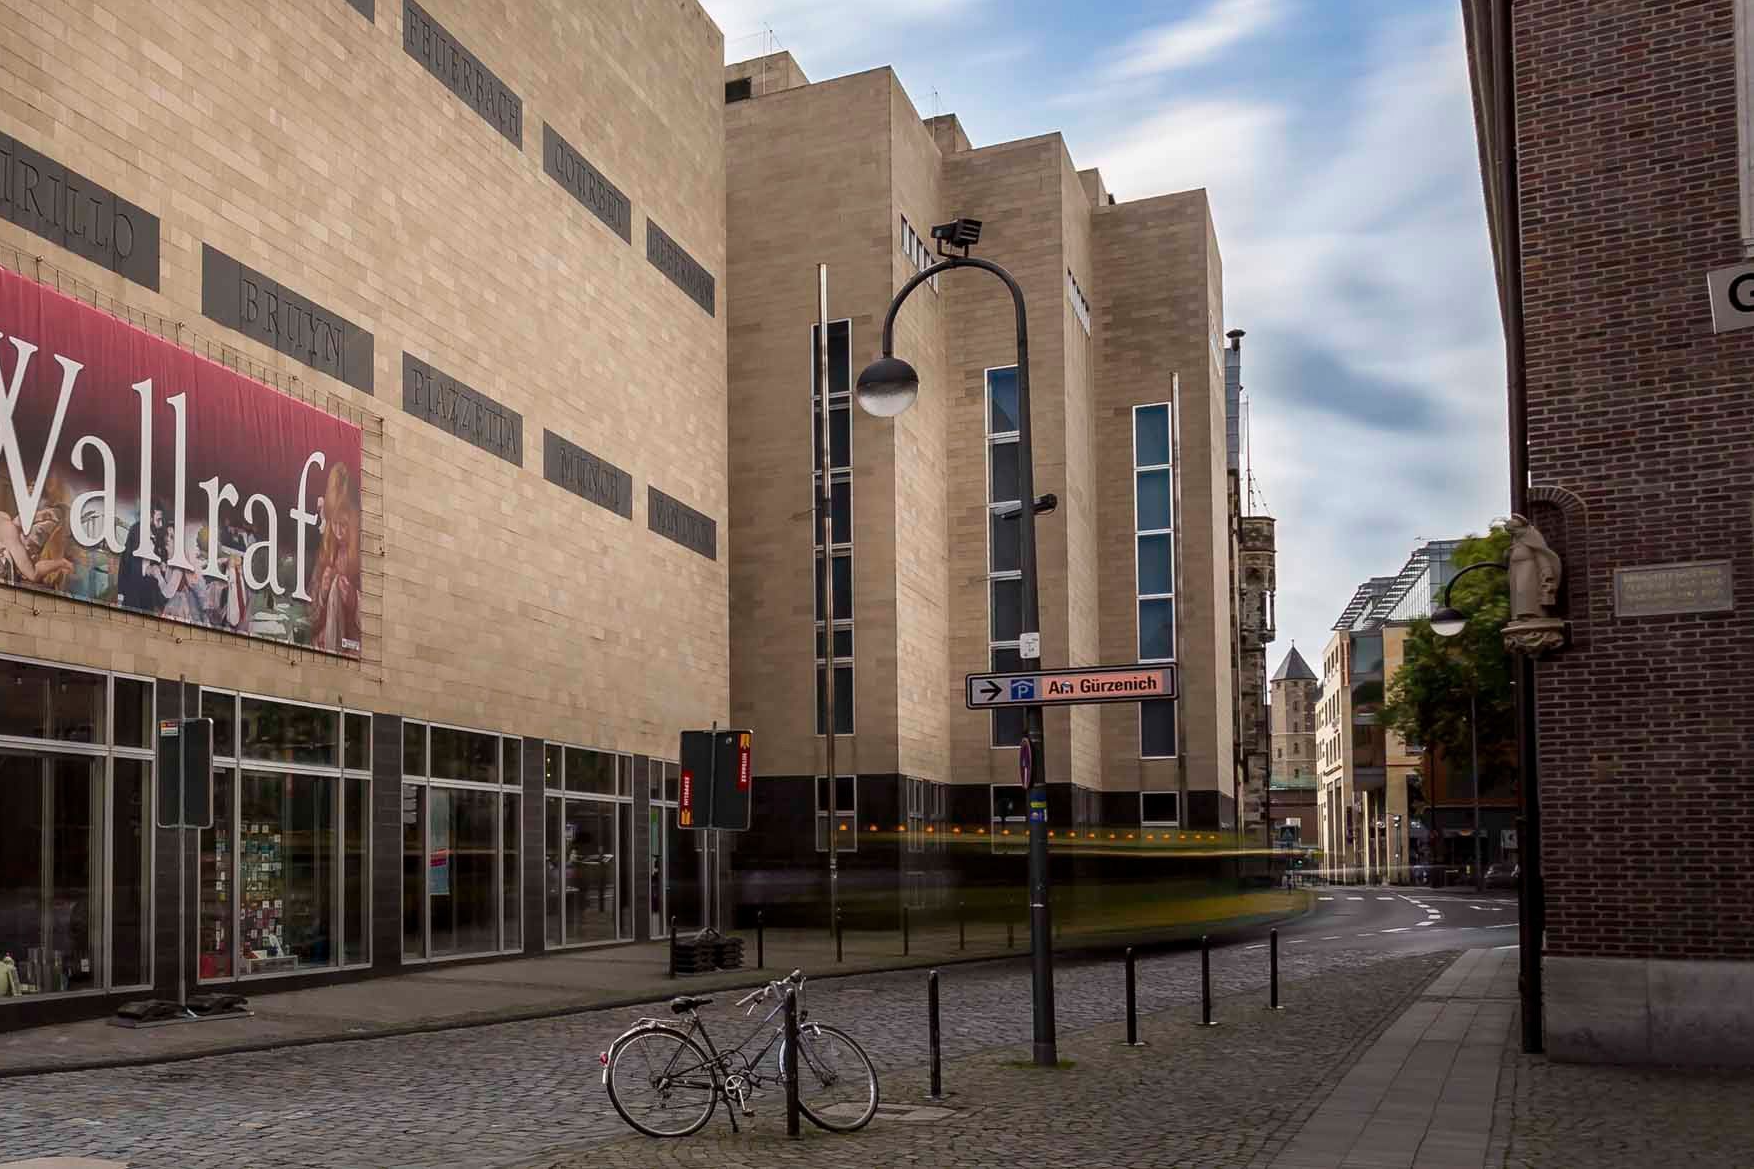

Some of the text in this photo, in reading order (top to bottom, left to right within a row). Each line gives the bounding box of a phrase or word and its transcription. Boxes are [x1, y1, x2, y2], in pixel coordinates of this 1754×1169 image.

[406, 7, 520, 136] FEUERBACH
[554, 142, 622, 229] COURBET
[241, 278, 343, 367] BRUYN
[411, 368, 517, 455] PIAZZETTA
[1080, 676, 1157, 694] Gürzenich
